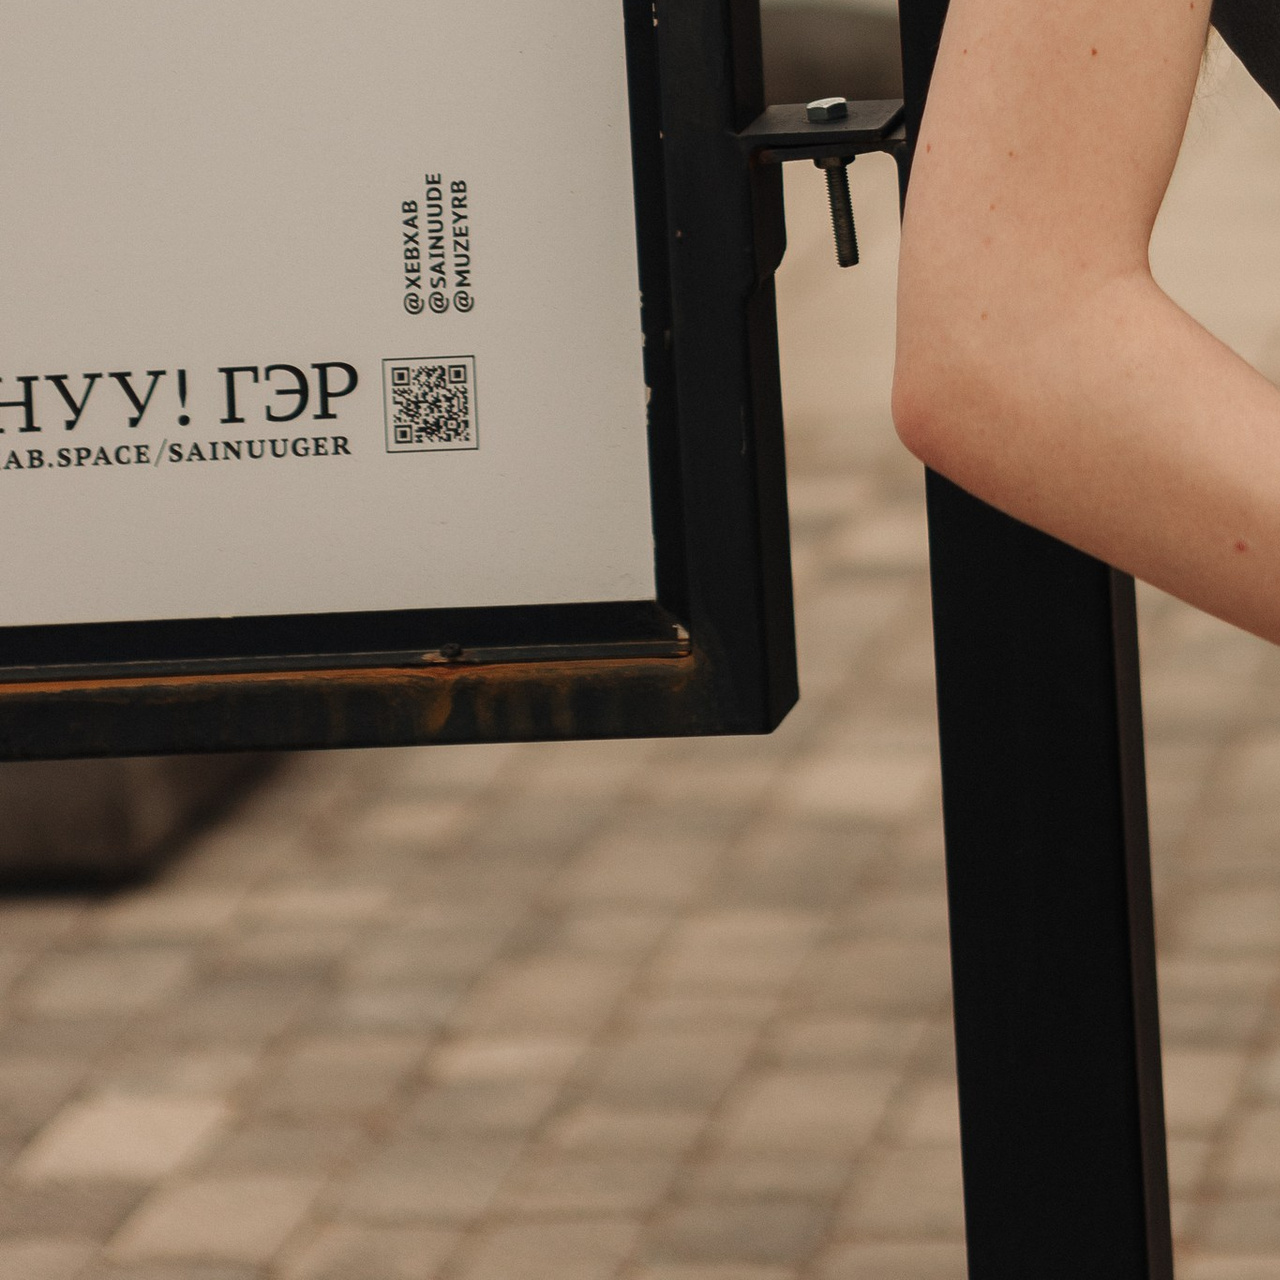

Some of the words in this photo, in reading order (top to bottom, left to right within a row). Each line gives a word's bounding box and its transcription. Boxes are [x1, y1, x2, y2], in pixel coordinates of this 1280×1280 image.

[402, 199, 425, 316] @XEBXAB
[425, 172, 450, 314] @SAINUUDE
[450, 179, 475, 313] @MUZEYRB
[217, 361, 360, 425] ГЭР
[0, 435, 352, 470] AB.SPACE/SAINUUGER
